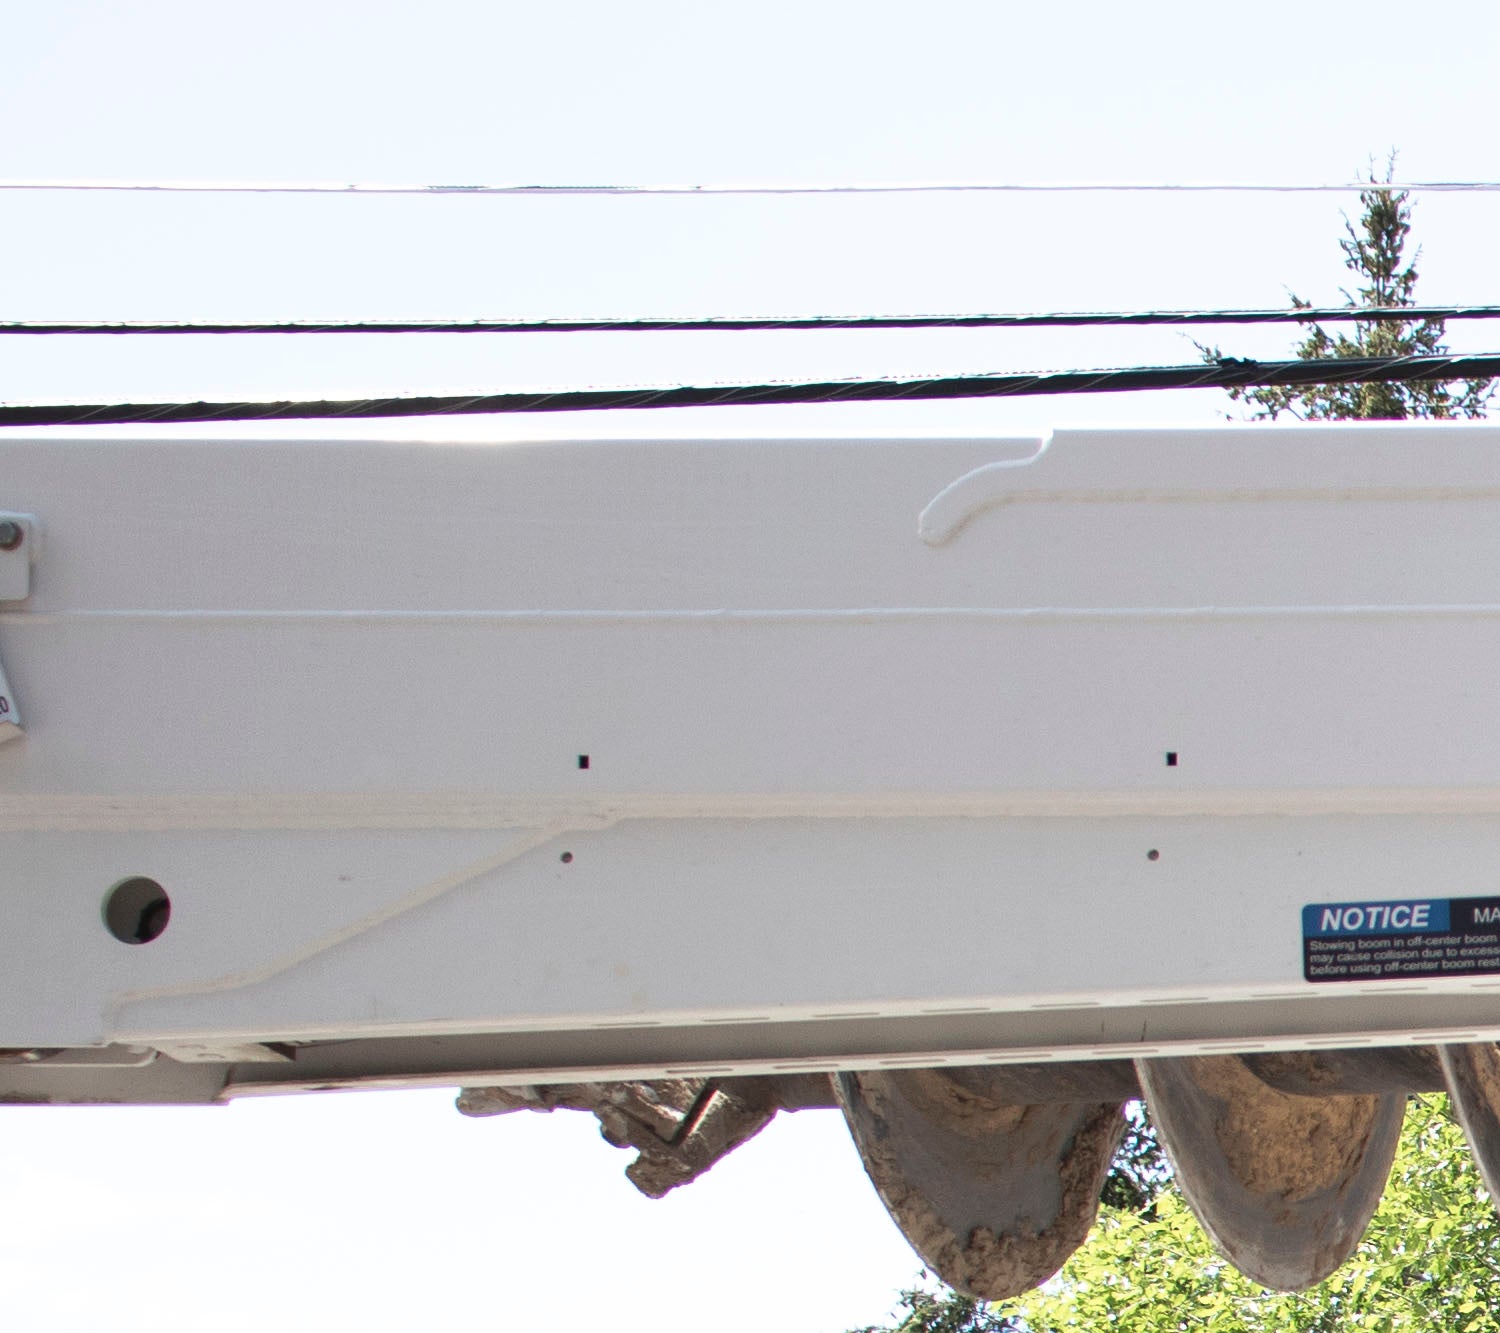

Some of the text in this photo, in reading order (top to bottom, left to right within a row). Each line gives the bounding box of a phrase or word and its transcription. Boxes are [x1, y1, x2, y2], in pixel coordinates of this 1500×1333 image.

[1320, 904, 1431, 931] NOTICE
[1309, 940, 1355, 952] Stowing
[1358, 939, 1391, 949] boom
[1394, 938, 1405, 948] in
[1407, 936, 1461, 947] off-center
[1464, 933, 1498, 944] boom
[1309, 953, 1334, 964] may
[1336, 952, 1371, 962] cause
[1373, 949, 1419, 960] collision
[1421, 947, 1444, 958] due
[1446, 946, 1457, 957] to
[1309, 963, 1347, 975] before
[1350, 961, 1381, 974] using
[1384, 959, 1439, 971] off-center
[1441, 957, 1475, 969] boom
